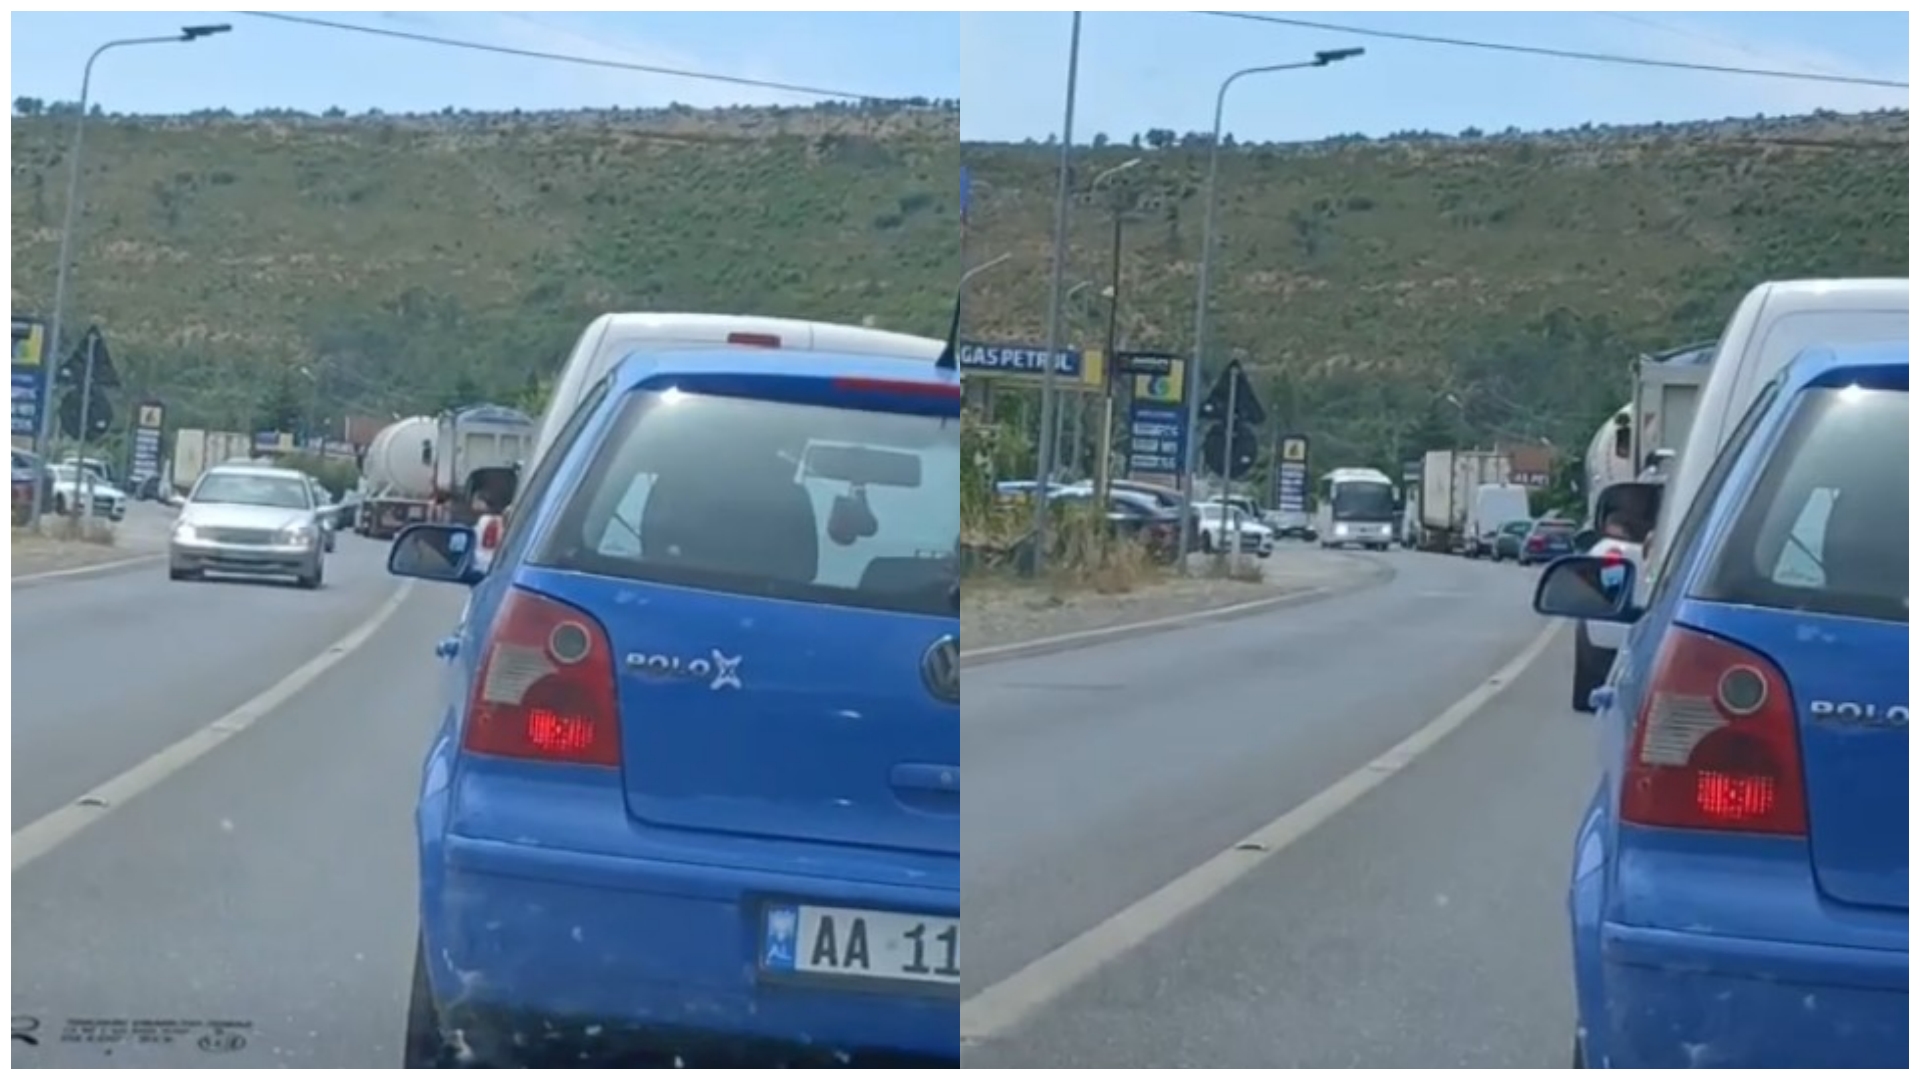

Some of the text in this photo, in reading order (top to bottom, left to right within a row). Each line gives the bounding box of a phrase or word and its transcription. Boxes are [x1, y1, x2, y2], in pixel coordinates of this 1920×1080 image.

[961, 344, 998, 366] GAS
[811, 914, 960, 976] AA 11
